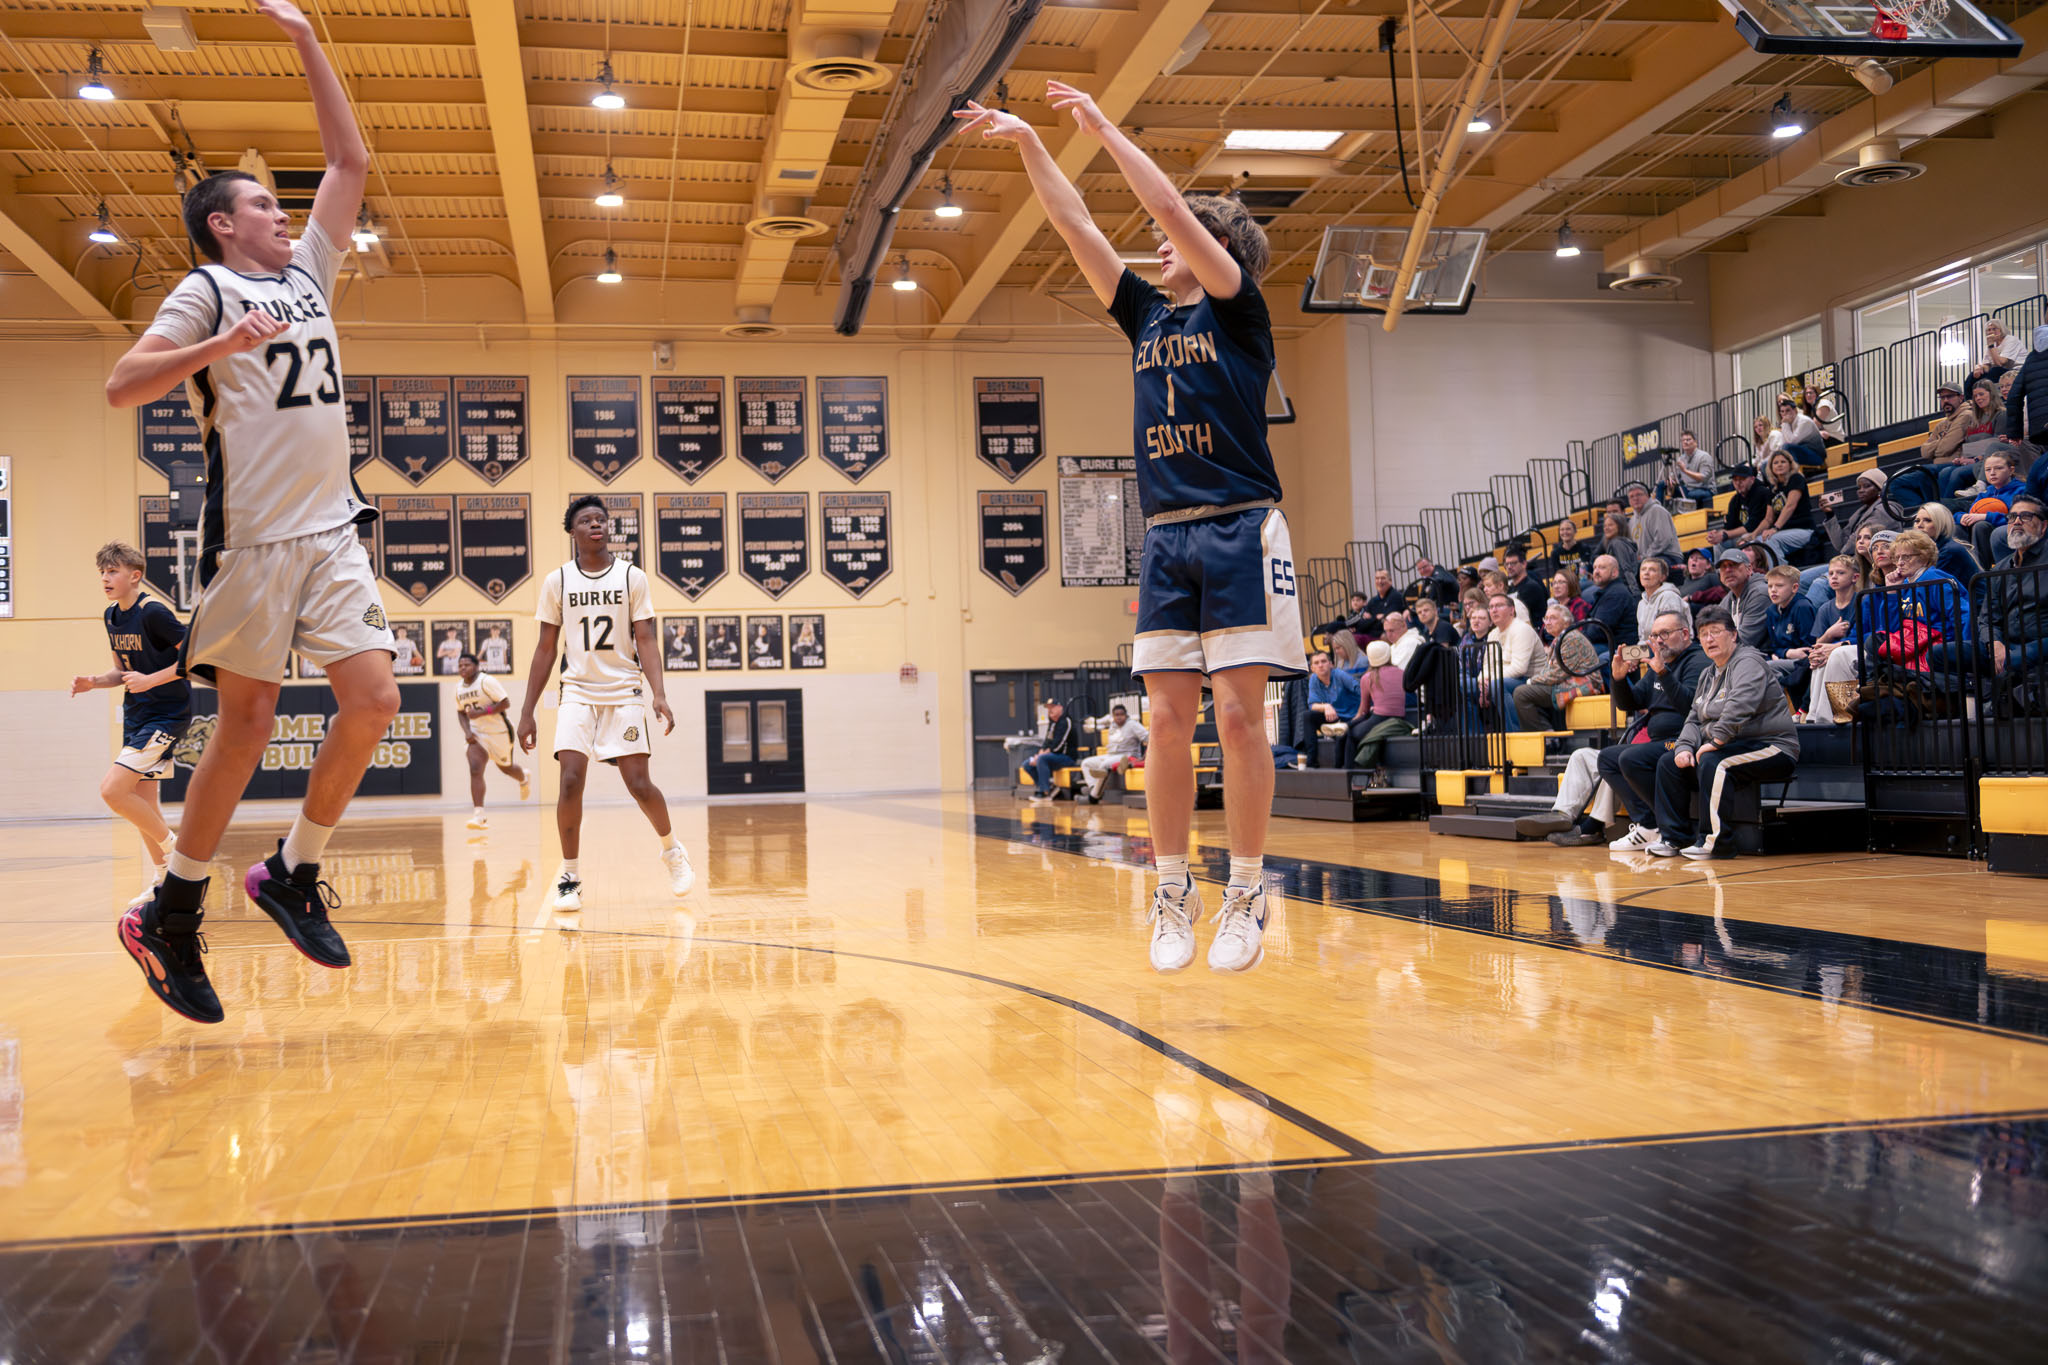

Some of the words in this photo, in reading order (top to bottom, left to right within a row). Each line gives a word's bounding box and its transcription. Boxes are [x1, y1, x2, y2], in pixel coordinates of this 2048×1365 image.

[265, 336, 341, 410] 23
[1804, 365, 1834, 390] BURKE
[1166, 374, 1175, 416] 1
[1146, 423, 1214, 460] SOUTH
[1637, 430, 1659, 454] BAND
[1080, 459, 1116, 470] BURKE
[397, 499, 435, 509] SOFTBALL
[466, 498, 488, 508] GIRLS
[491, 497, 519, 508] SOCCER
[605, 497, 632, 507] TENNIS
[670, 497, 690, 507] GIRLS
[692, 497, 710, 506] GOLF
[1063, 578, 1099, 586] TRACK
[1101, 578, 1125, 586] AND
[1271, 558, 1295, 596] ES
[569, 590, 623, 607] BURKE
[579, 615, 614, 651] 12
[381, 713, 431, 739] HE
